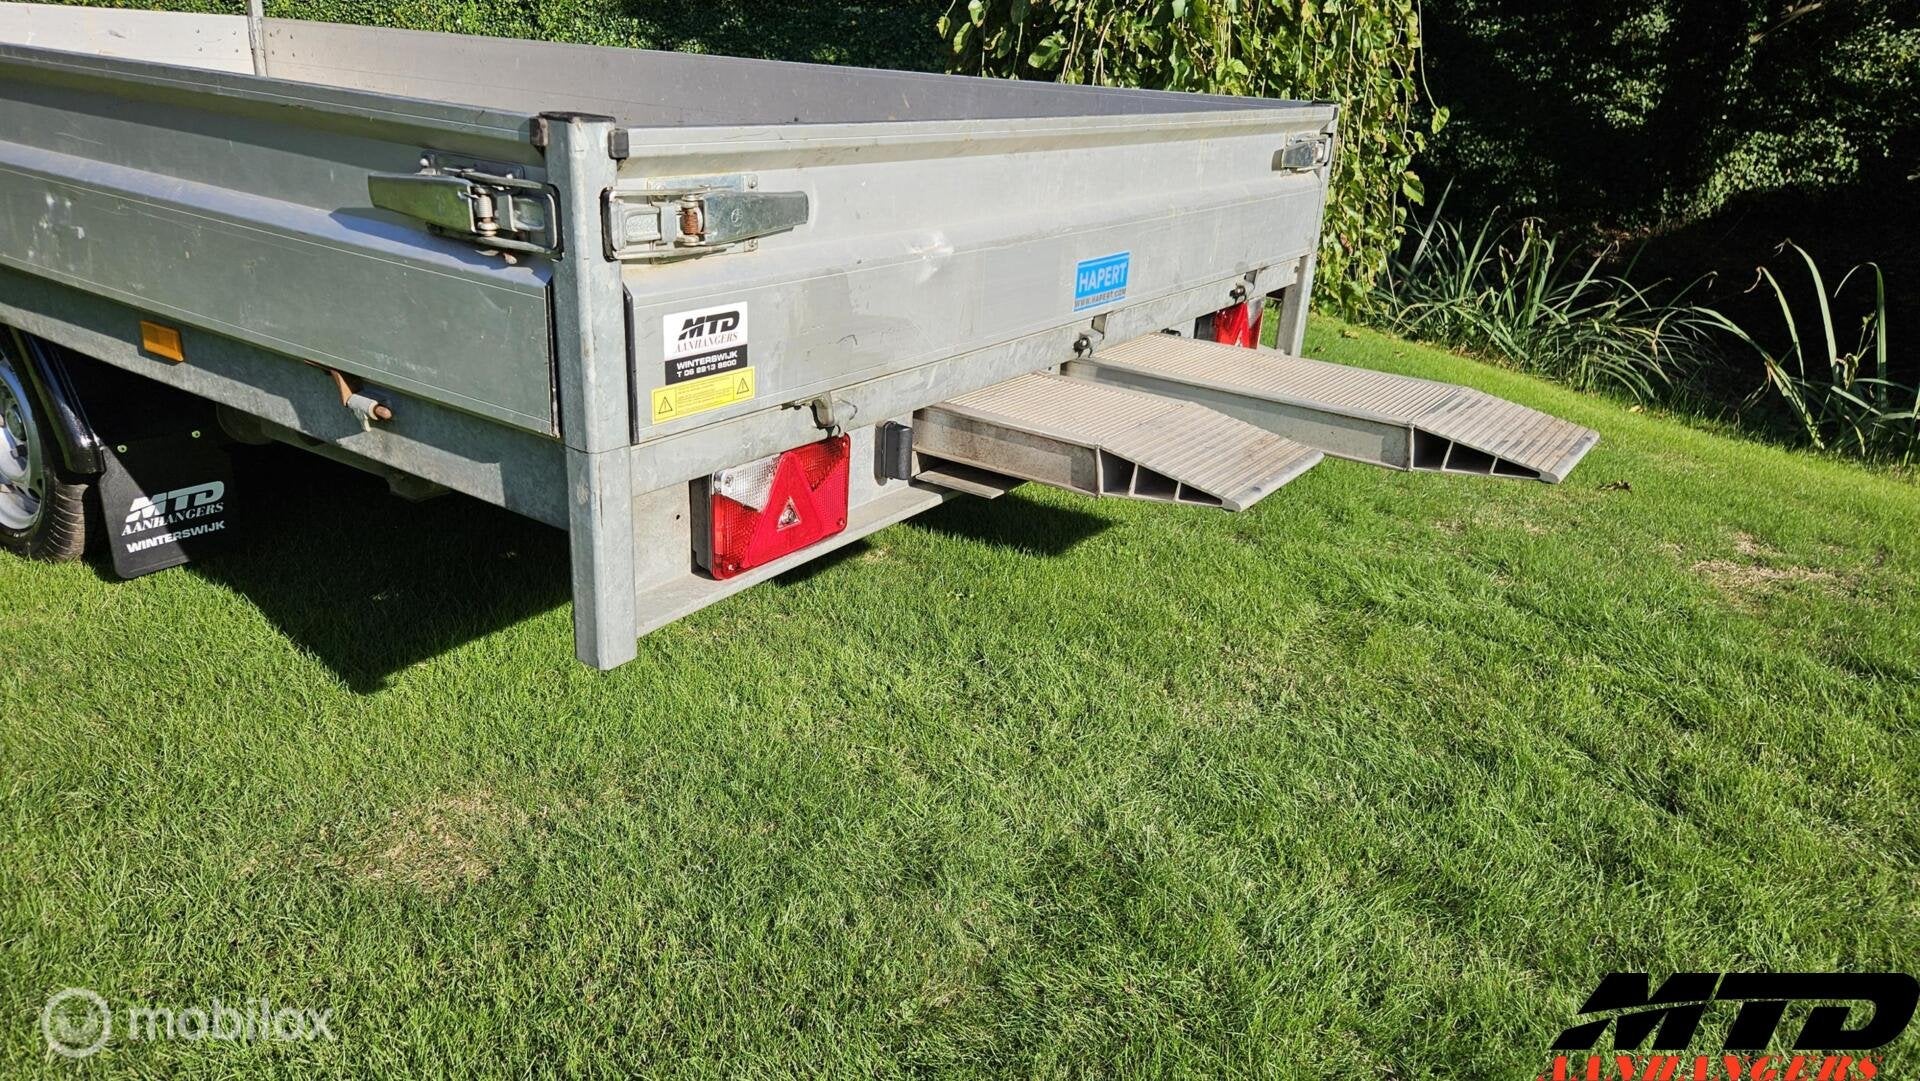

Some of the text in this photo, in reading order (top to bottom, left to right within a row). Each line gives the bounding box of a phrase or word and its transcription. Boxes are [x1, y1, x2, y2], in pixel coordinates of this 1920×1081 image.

[1078, 262, 1127, 293] HAPERT
[678, 310, 740, 341] MTD
[676, 332, 738, 353] AANHANGERS
[677, 350, 738, 370] WINTERSWIJK
[125, 481, 225, 523] MTD
[121, 502, 224, 537] AANHANGERS
[126, 520, 225, 553] WINTERSWIJK
